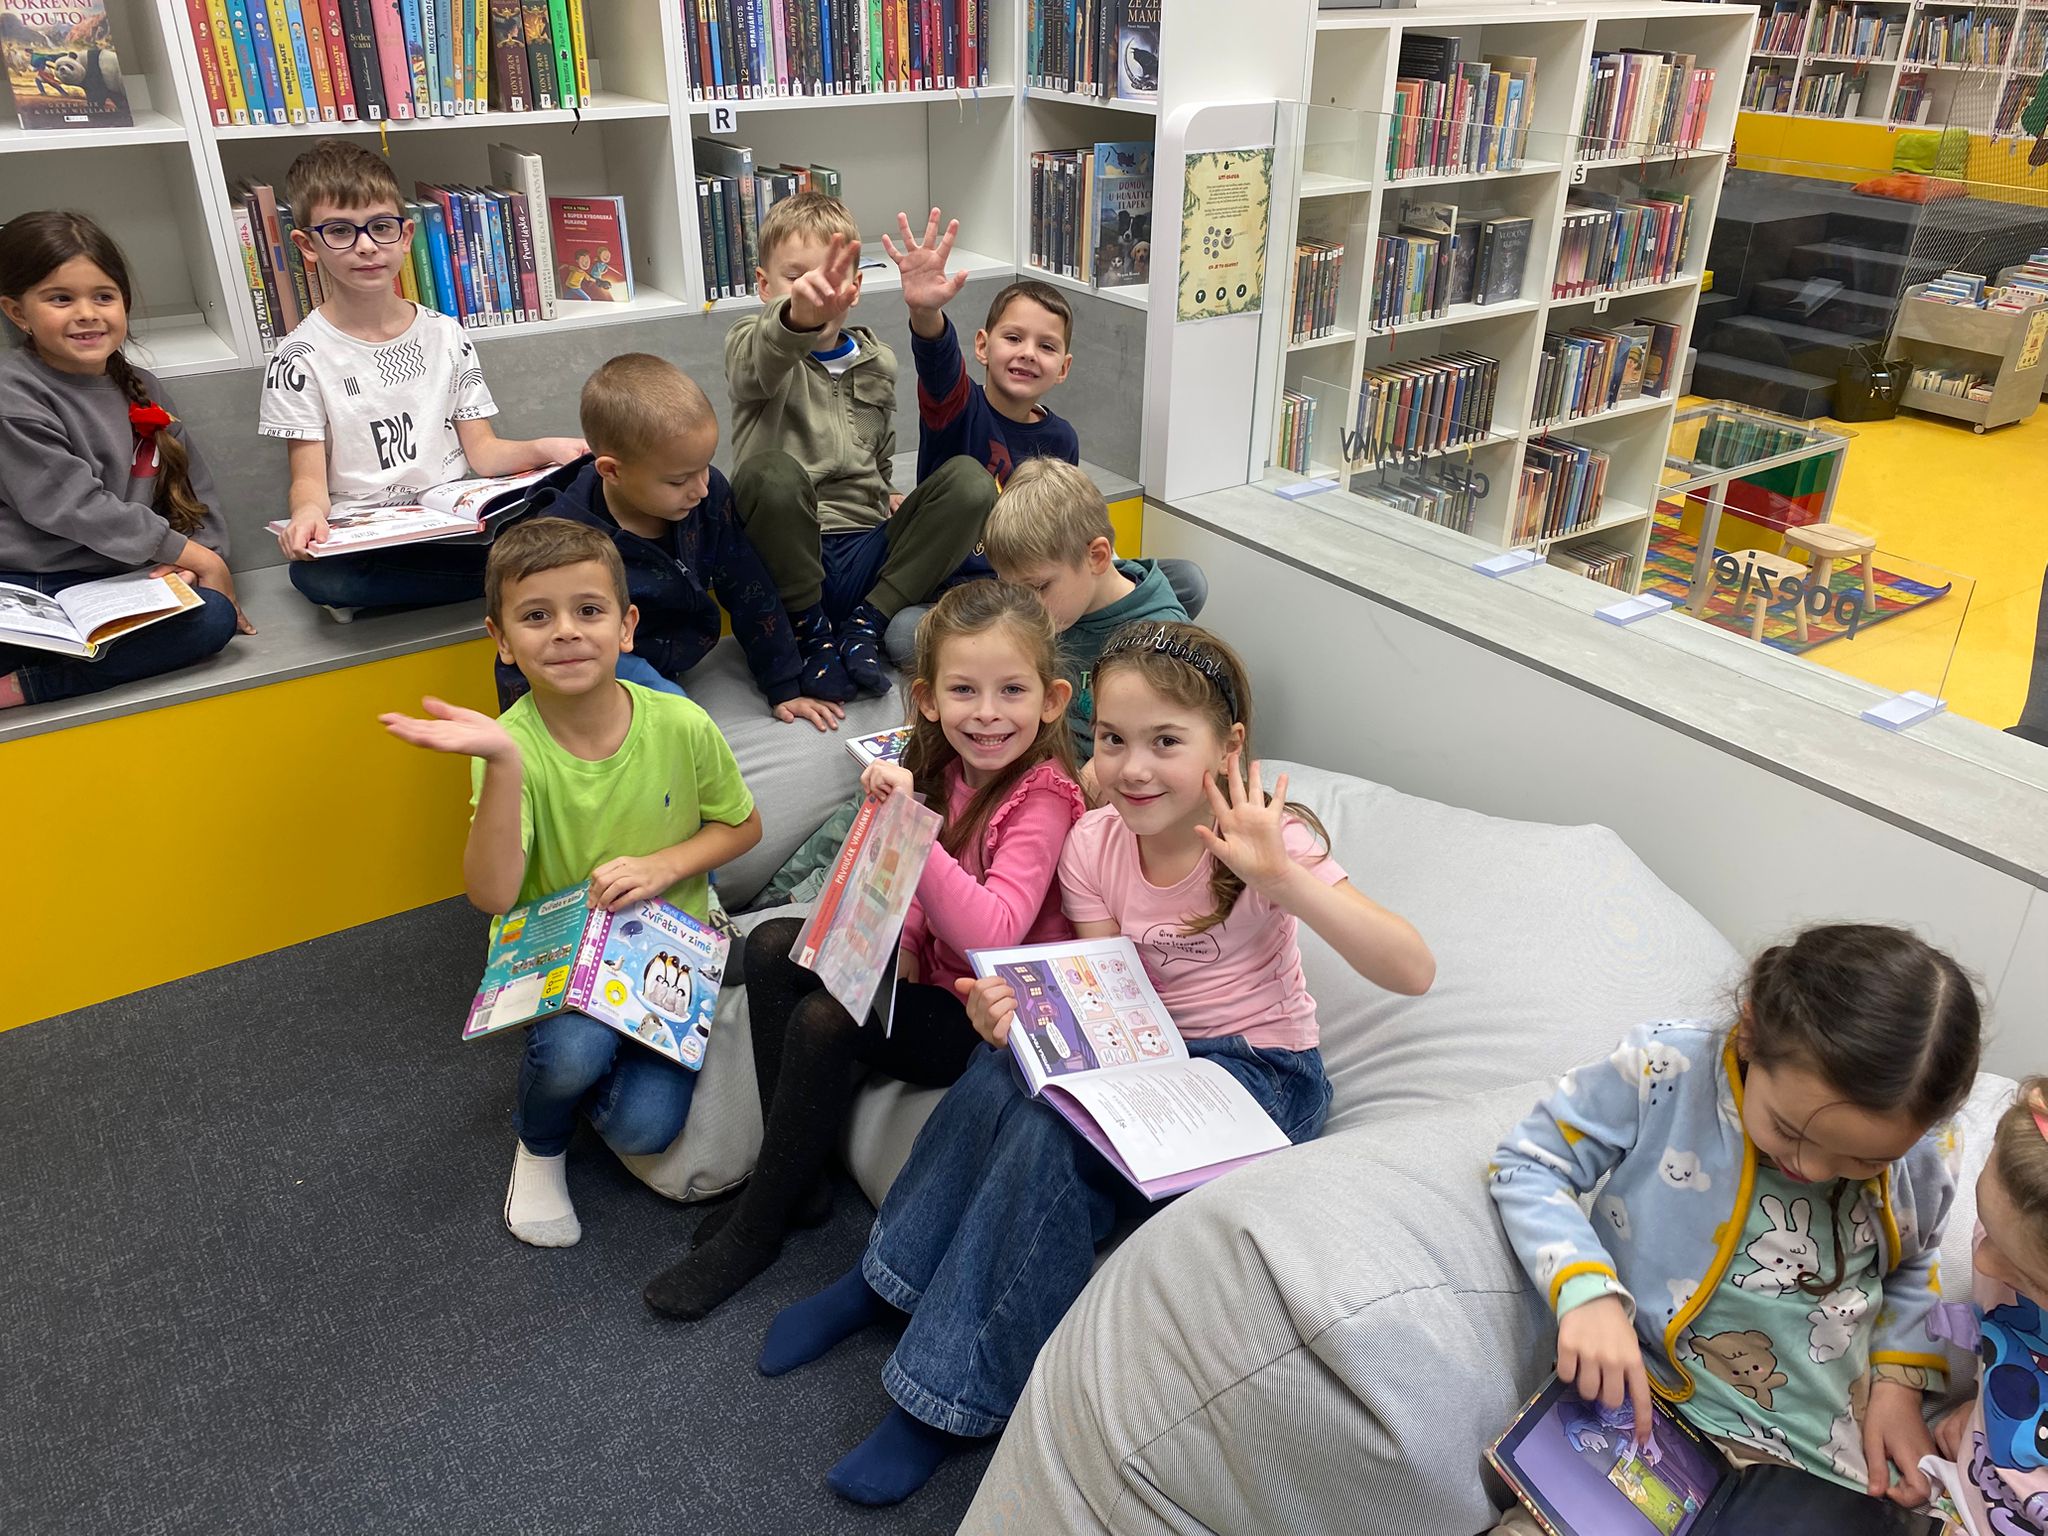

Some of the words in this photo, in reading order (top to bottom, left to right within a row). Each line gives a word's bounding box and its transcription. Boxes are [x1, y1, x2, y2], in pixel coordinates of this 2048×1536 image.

[22, 12, 82, 26] POUTO
[1128, 10, 1161, 22] MAMU
[350, 33, 371, 41] Srdce
[747, 12, 756, 48] OPRAVÁŘI
[741, 68, 748, 82] 12
[715, 108, 730, 130] R
[1574, 164, 1583, 182] Š
[1118, 181, 1146, 190] DOMOV
[1116, 190, 1153, 200] HUŇATÝC
[1118, 201, 1146, 210] TLAPEK
[518, 215, 530, 238] láska
[522, 238, 532, 260] První
[248, 256, 260, 288] brenda
[253, 290, 267, 321] PAYNE
[1600, 298, 1606, 310] T
[266, 429, 282, 438] ONE
[284, 430, 296, 438] OF
[370, 412, 417, 470] EPIC
[1540, 543, 1546, 554] V
[836, 844, 857, 885] PAVOUČEK
[851, 808, 873, 846] VARHÁNEK
[641, 906, 678, 934] Zvířata
[680, 930, 687, 939] v
[688, 936, 712, 954] zimě
[1159, 930, 1174, 938] Give
[804, 952, 814, 964] K
